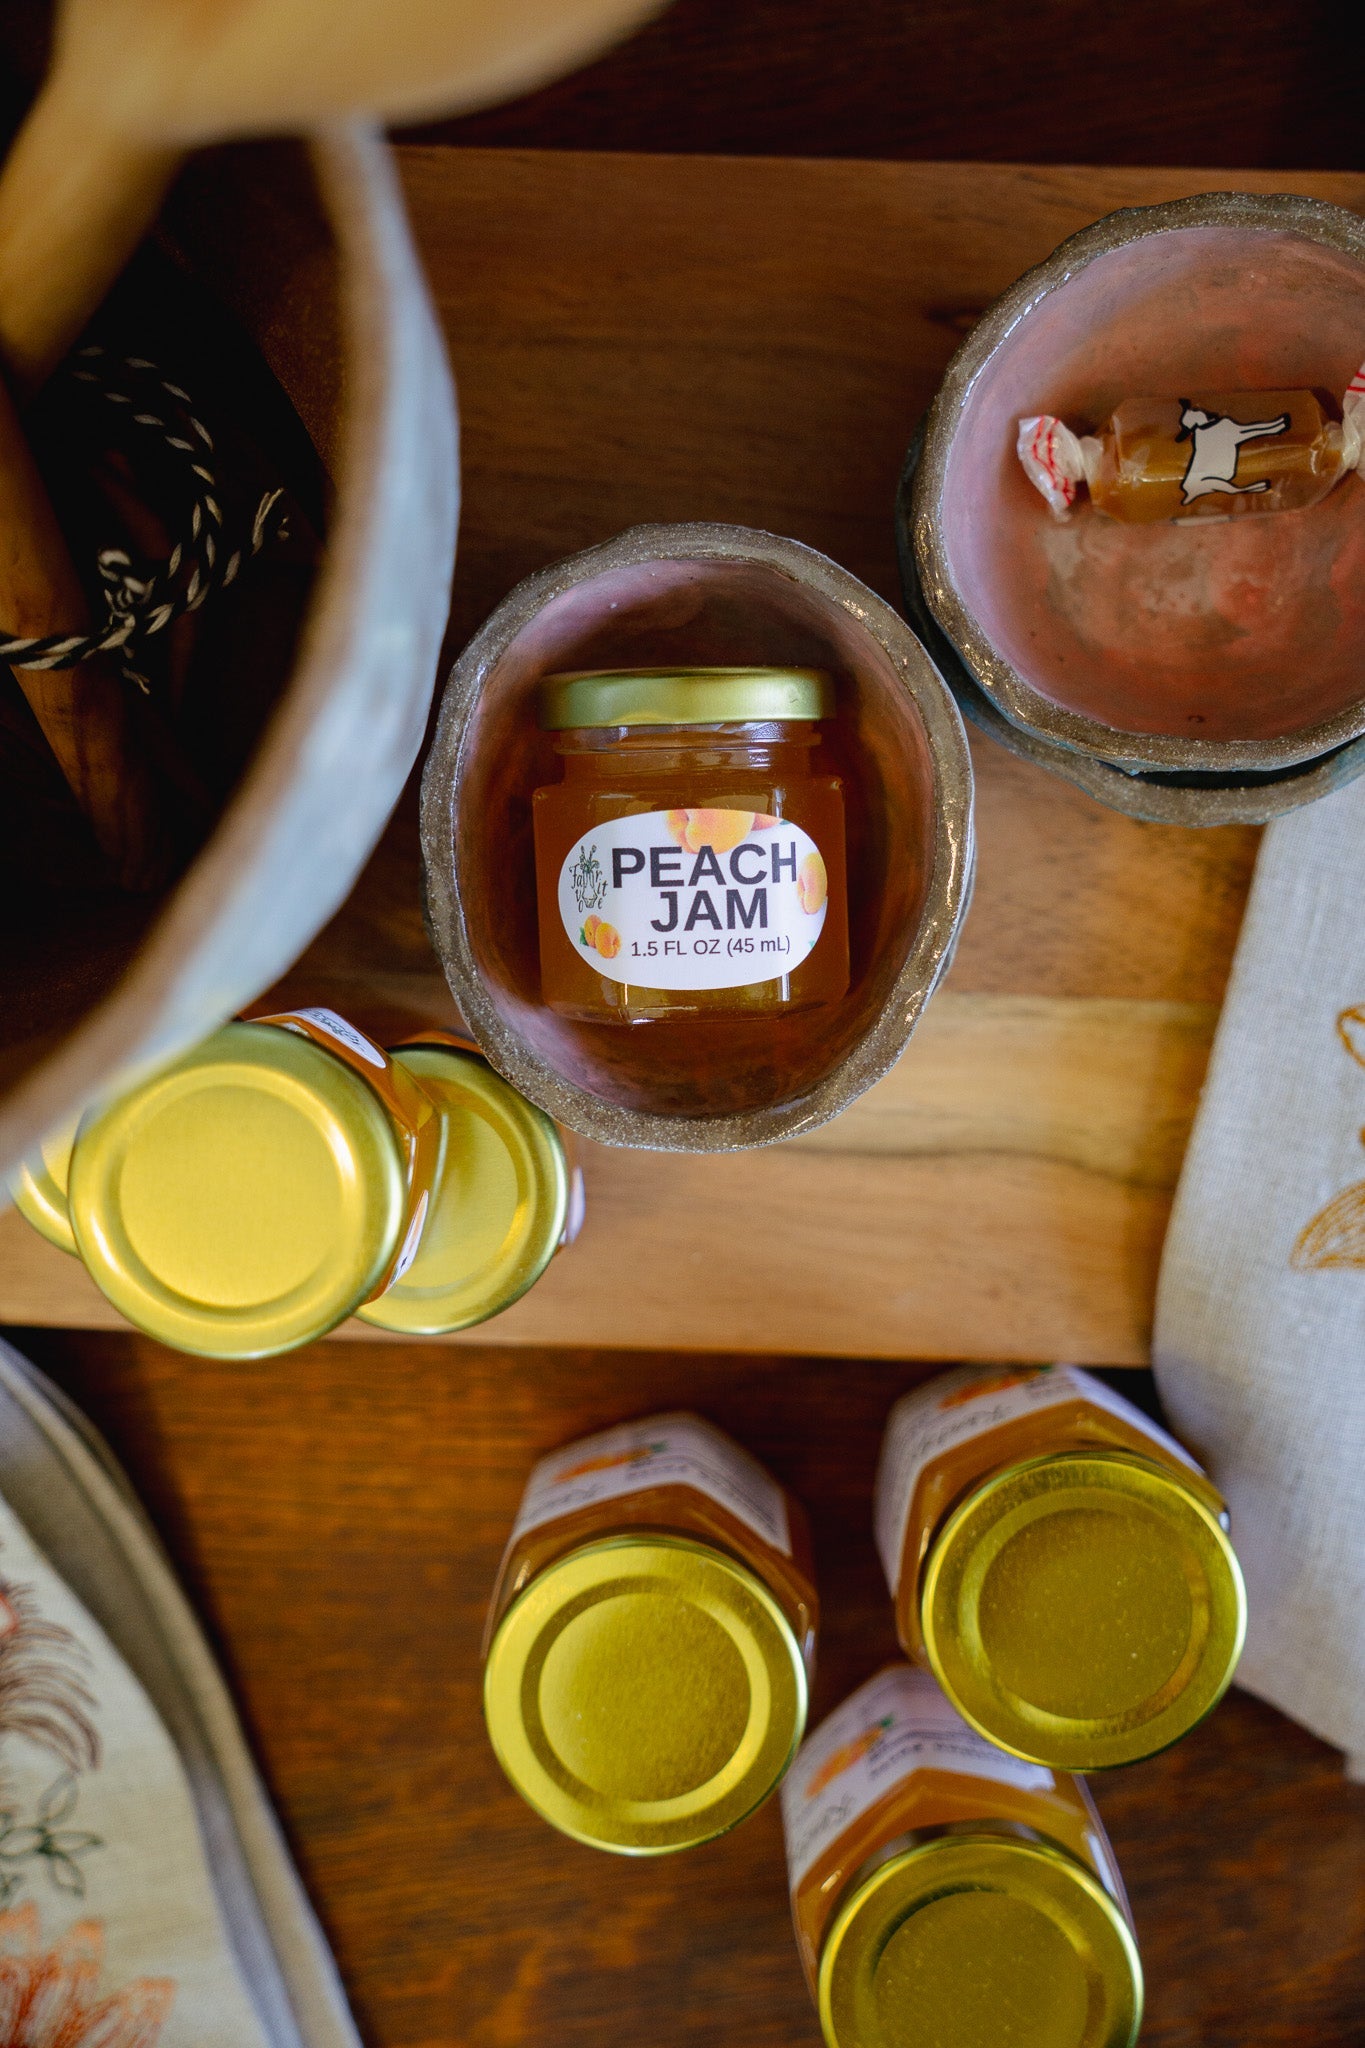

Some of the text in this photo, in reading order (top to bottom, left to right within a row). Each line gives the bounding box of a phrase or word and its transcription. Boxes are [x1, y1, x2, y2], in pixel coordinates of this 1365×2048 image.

[612, 842, 797, 888] PEACH
[651, 888, 768, 933] JAM
[631, 935, 791, 958] 1.5 FL OZ (45 mL)
